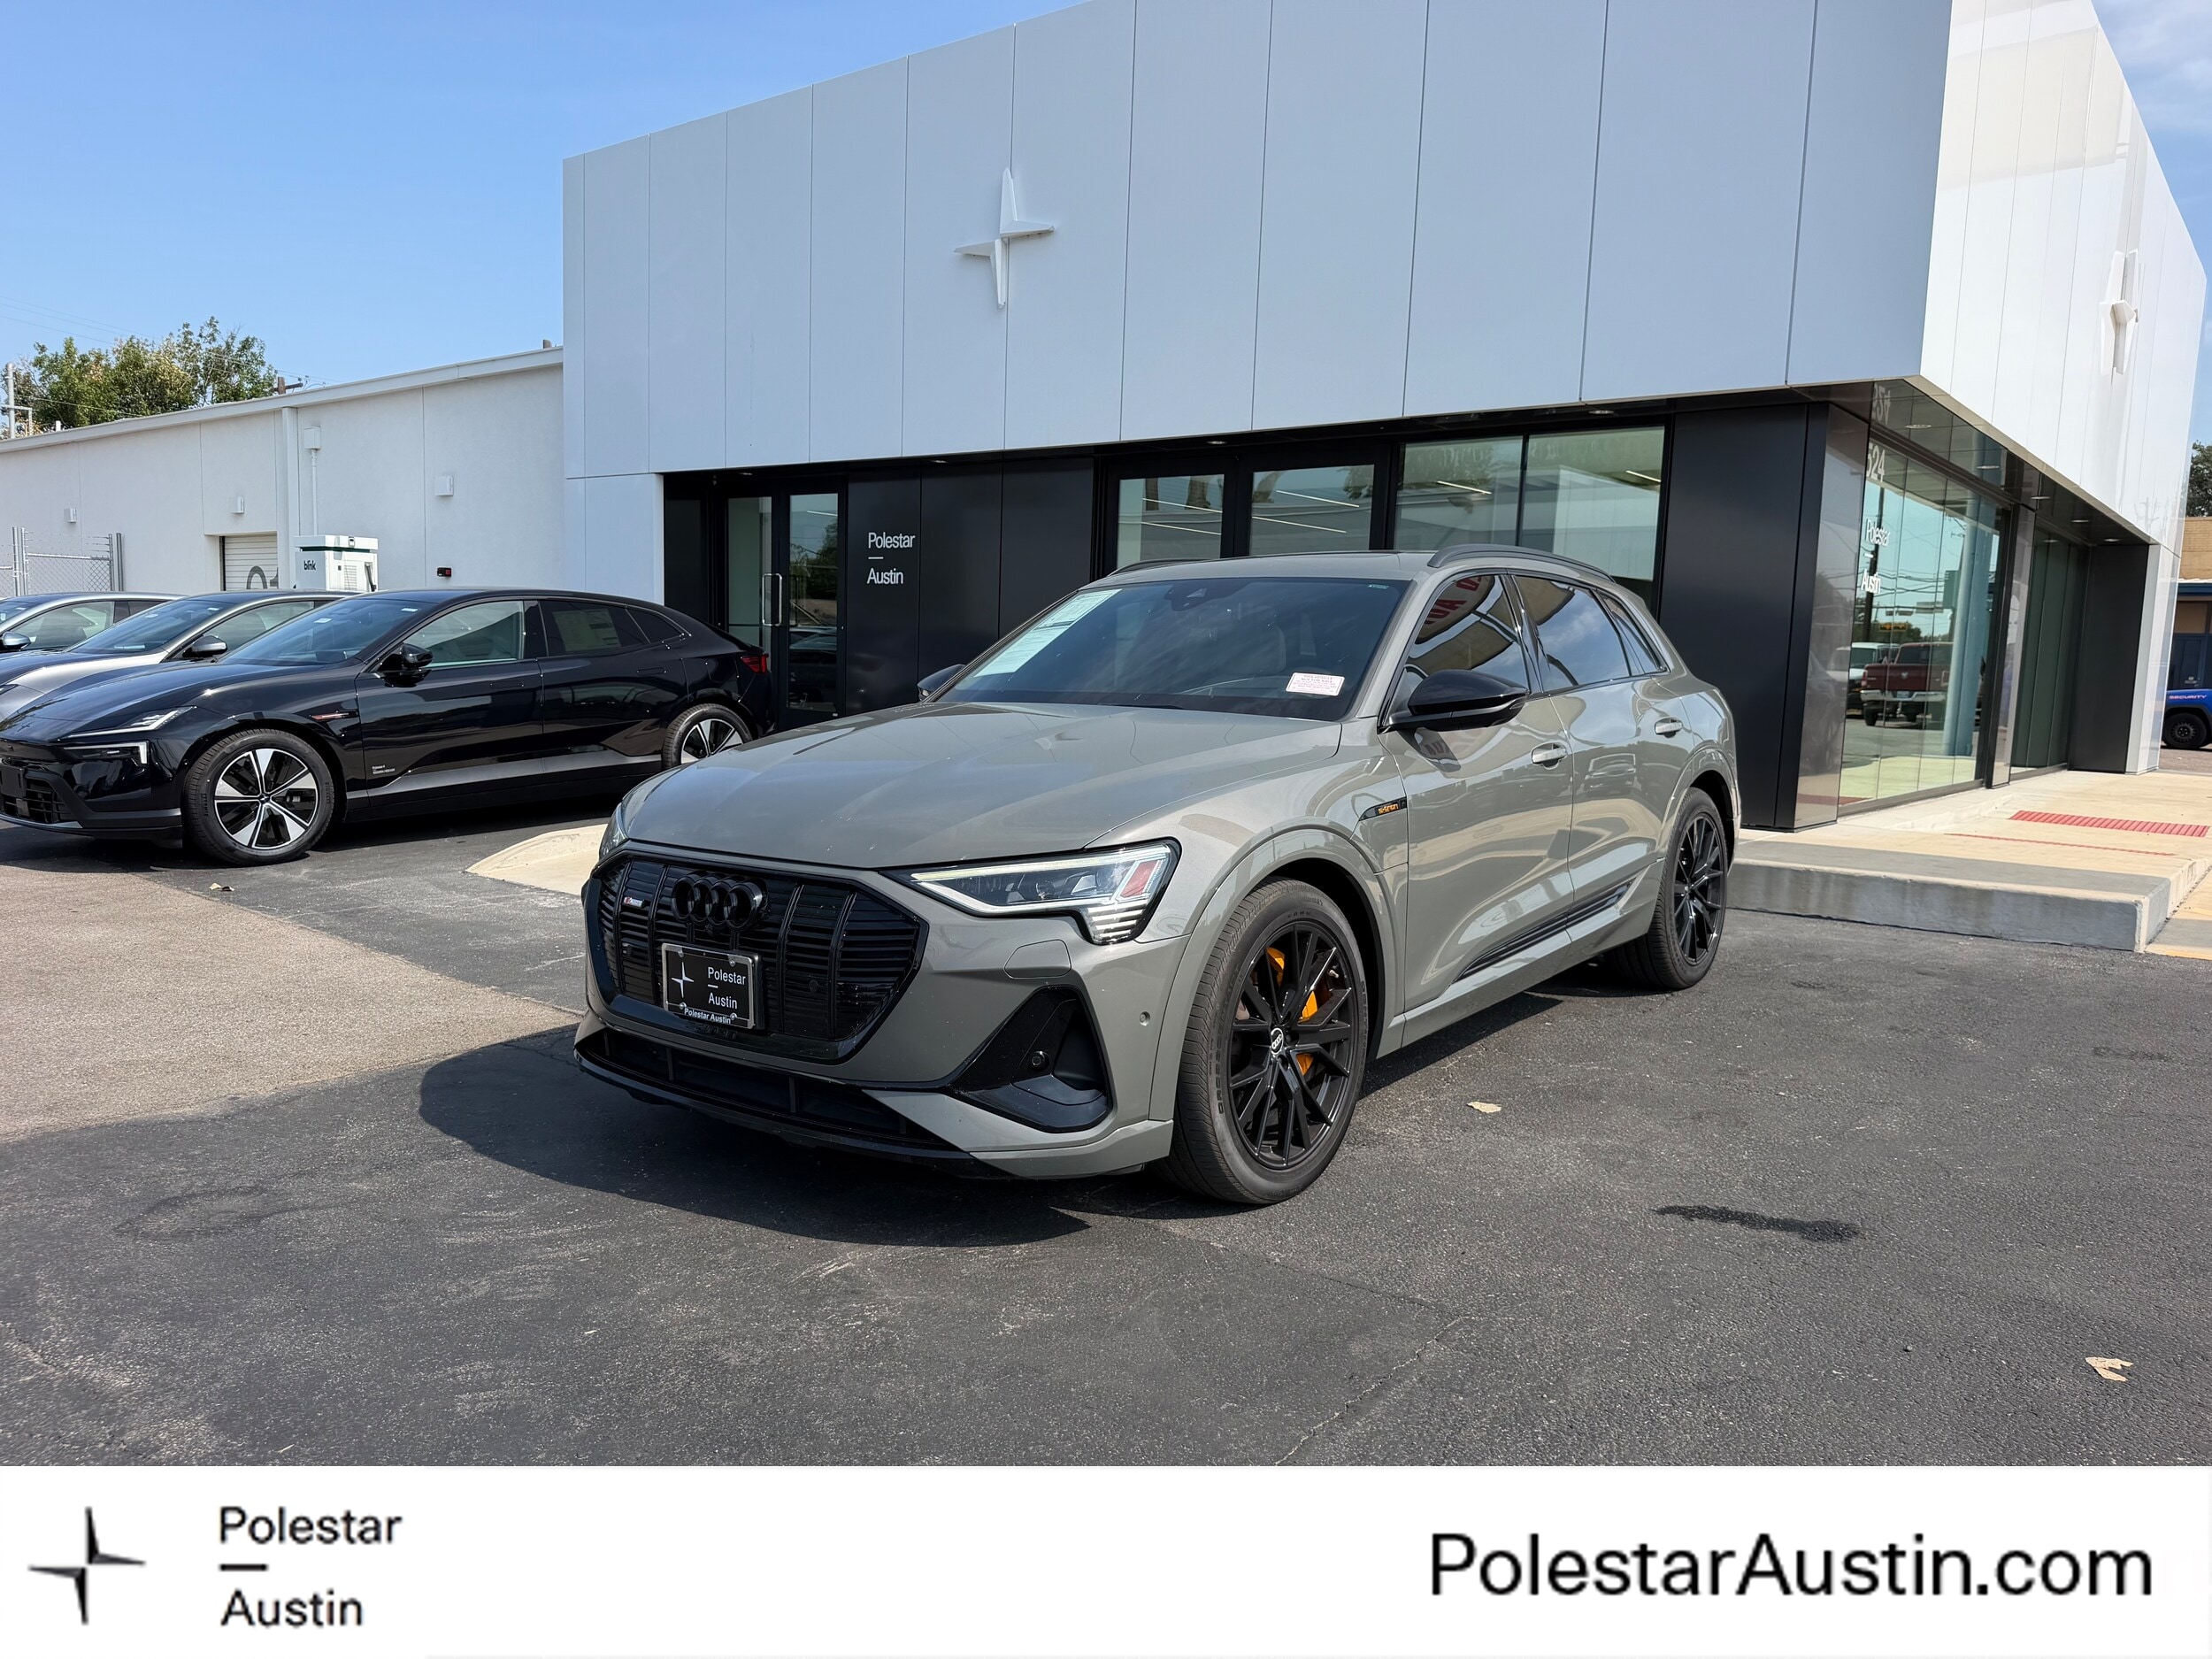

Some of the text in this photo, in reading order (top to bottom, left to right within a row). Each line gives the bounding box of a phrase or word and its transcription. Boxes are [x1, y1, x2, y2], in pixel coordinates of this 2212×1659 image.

[868, 531, 916, 549] Polestar
[1866, 518, 1891, 547] Polestar
[303, 560, 317, 571] blink
[867, 567, 904, 584] Austin
[1861, 568, 1881, 595] Austin
[708, 966, 747, 986] Polestar
[708, 992, 738, 1010] Austin
[684, 1007, 732, 1025] Polestar Austin
